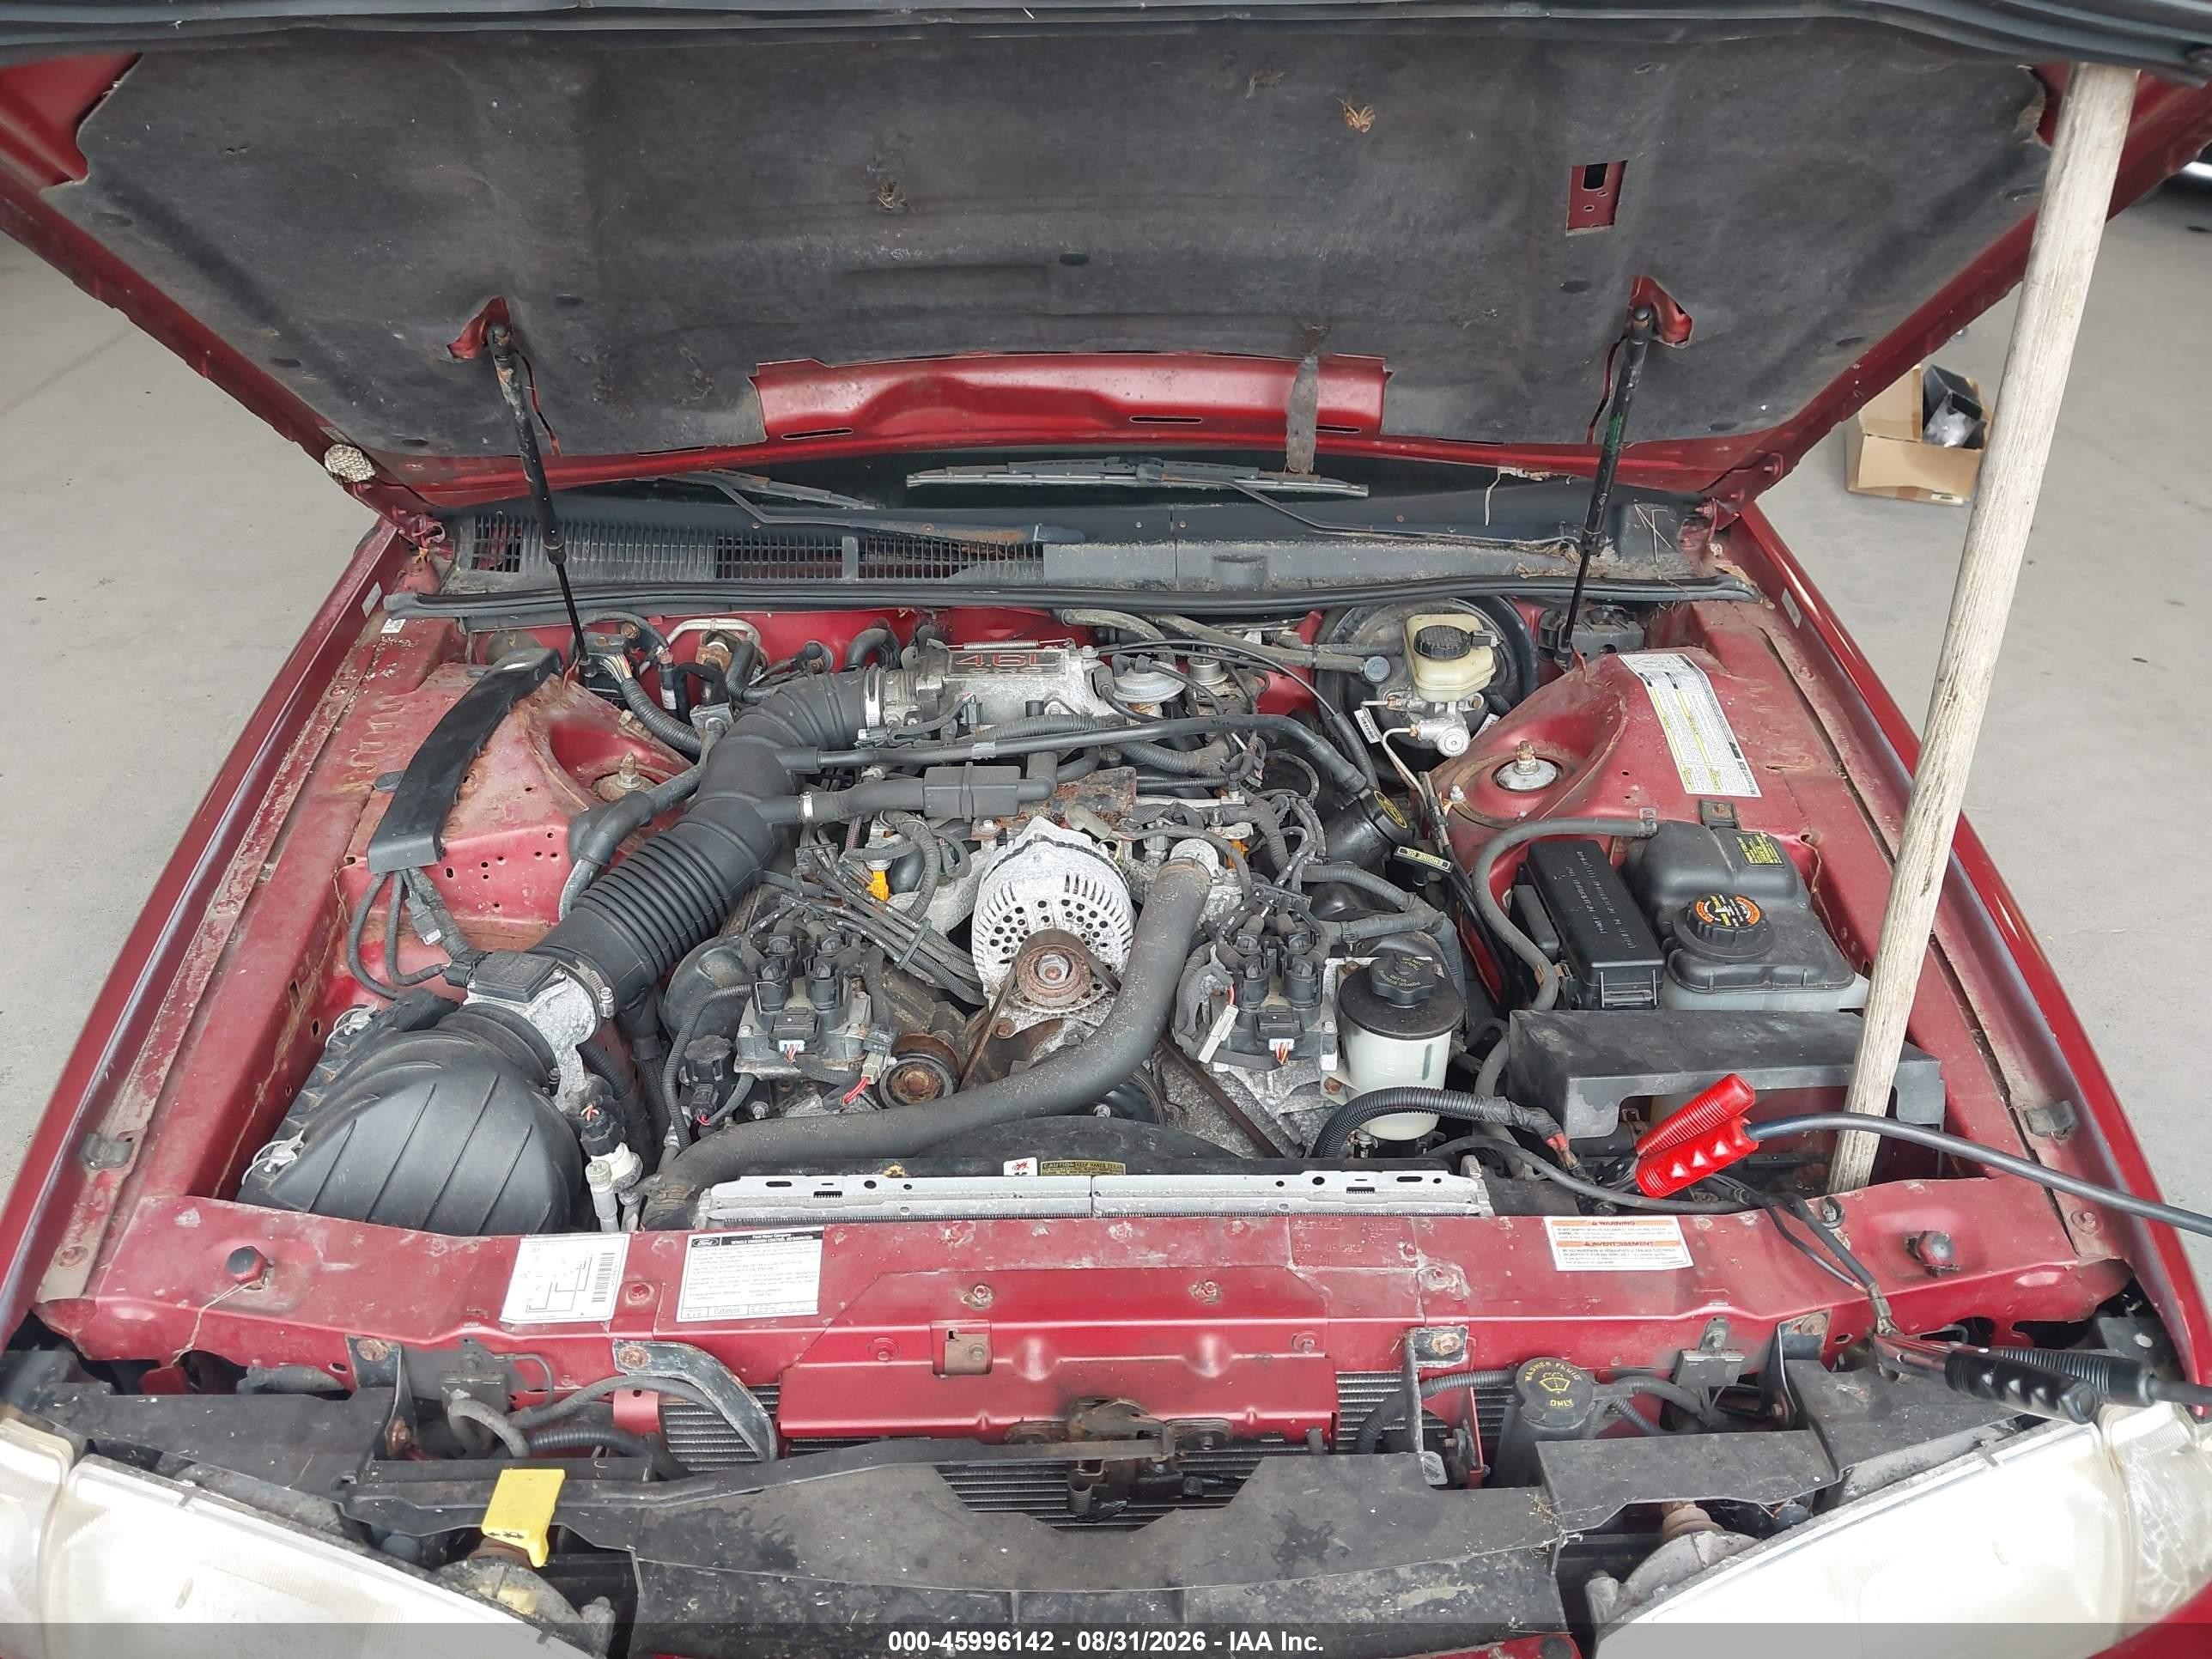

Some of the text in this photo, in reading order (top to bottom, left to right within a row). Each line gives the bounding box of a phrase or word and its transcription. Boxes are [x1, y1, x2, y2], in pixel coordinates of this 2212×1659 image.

[955, 653, 1059, 667] 4.6L
[1524, 1361, 1583, 1382] WASHER FLUID
[1549, 1398, 1574, 1408] ONLY
